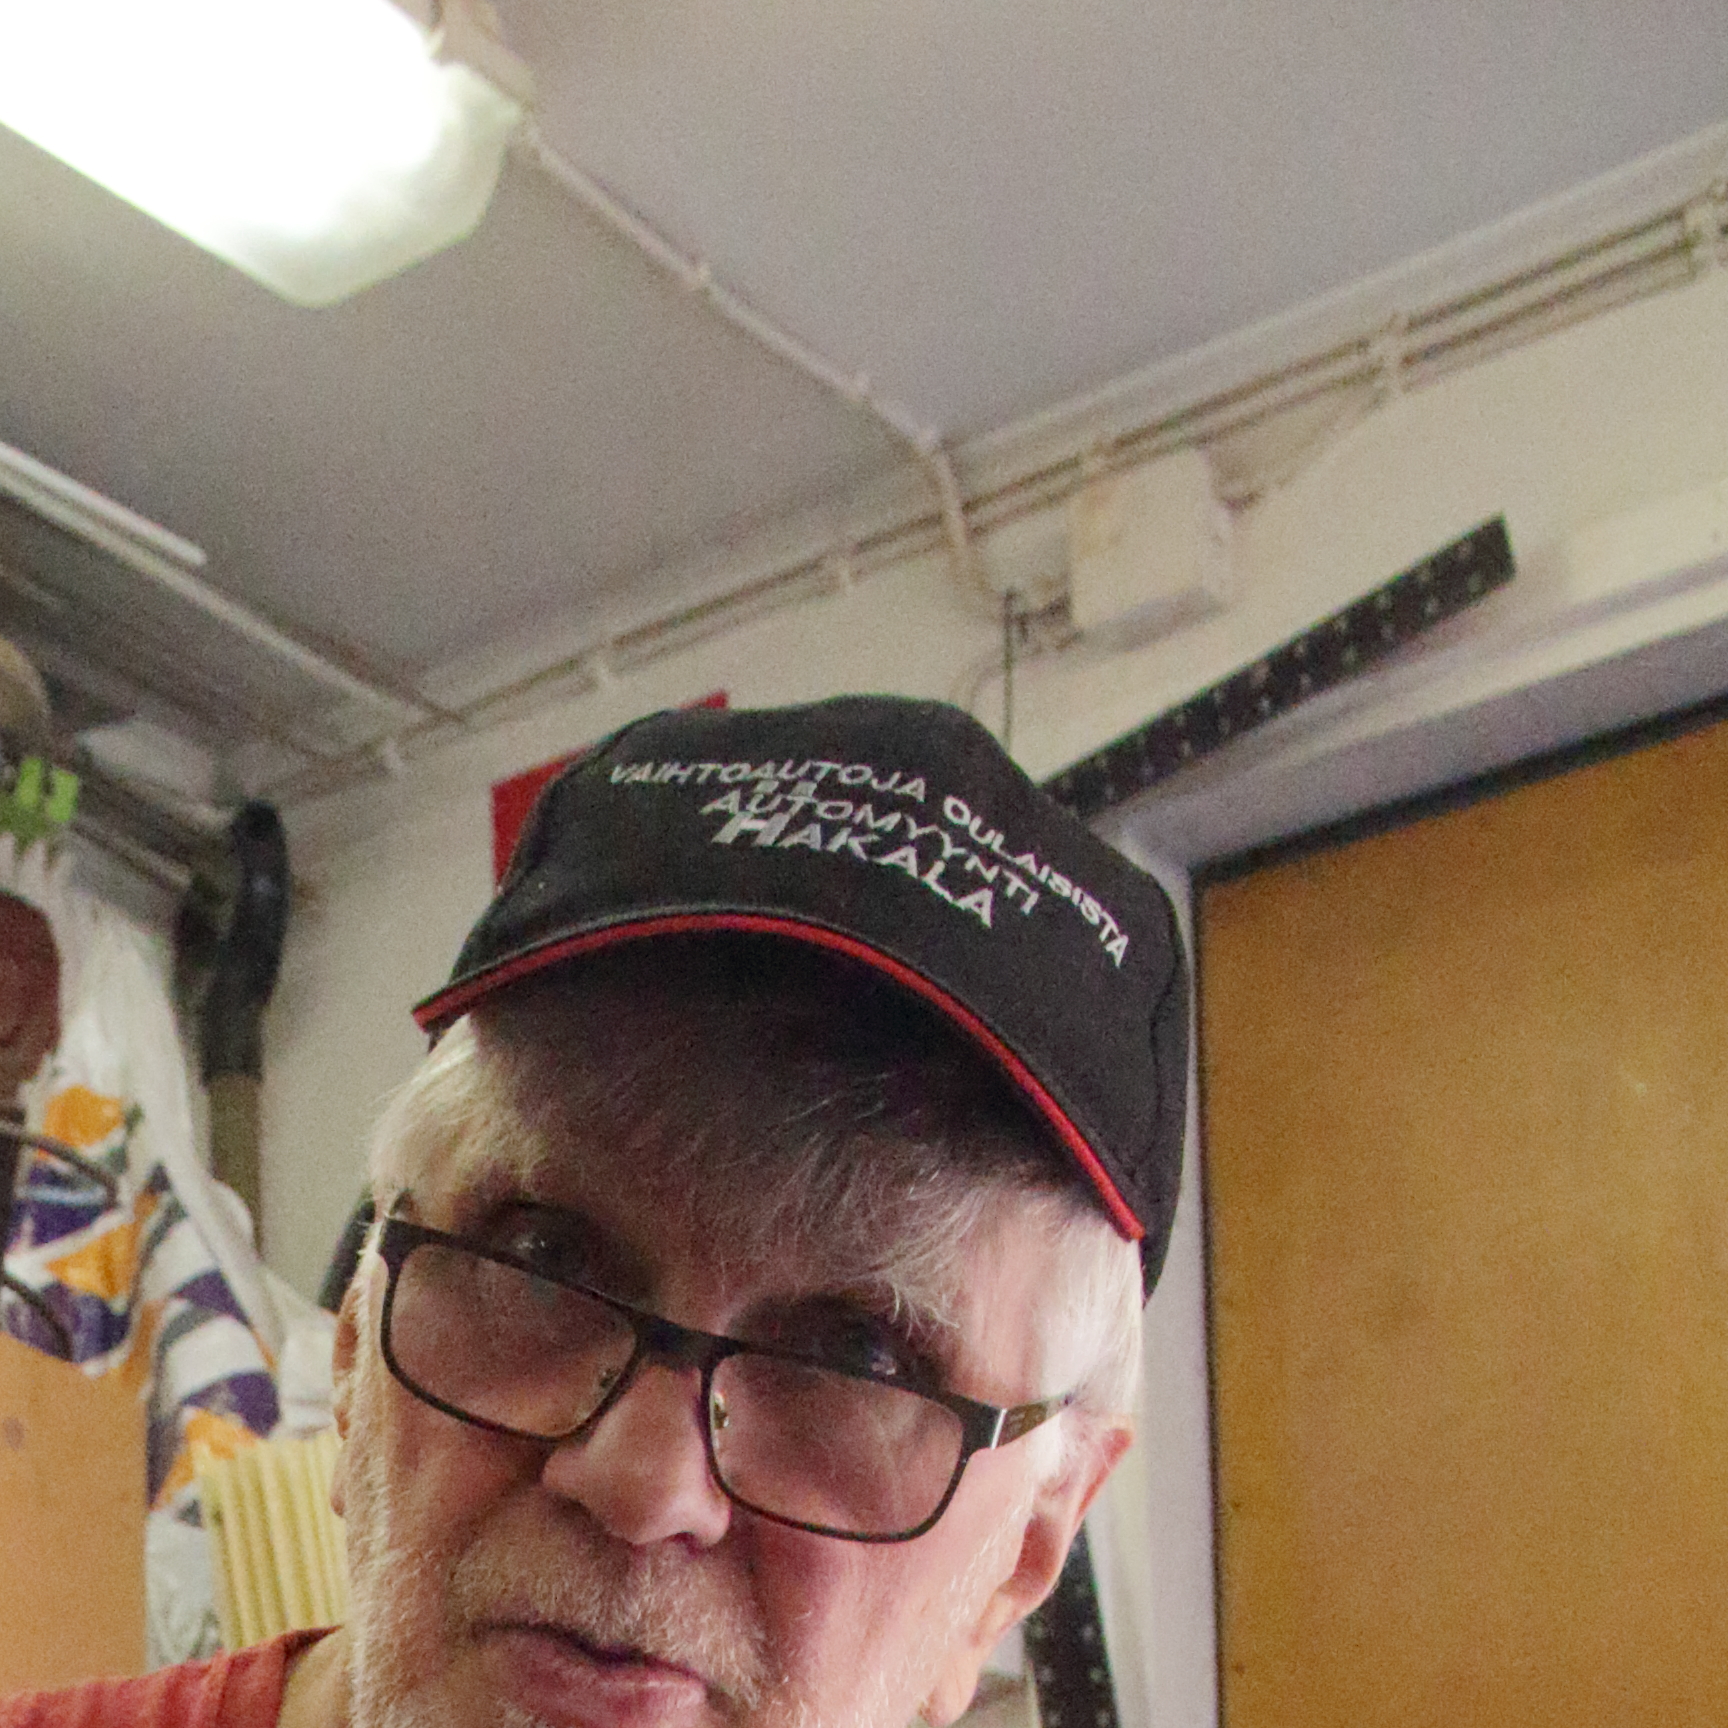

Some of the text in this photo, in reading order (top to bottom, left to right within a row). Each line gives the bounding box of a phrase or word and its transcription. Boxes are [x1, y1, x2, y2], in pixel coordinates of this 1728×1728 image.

[610, 759, 1128, 968] VAIHTOAUTOJA OULAISISTA
[699, 789, 1039, 914] AUTOMYYNTI
[711, 780, 992, 928] HAKALA
